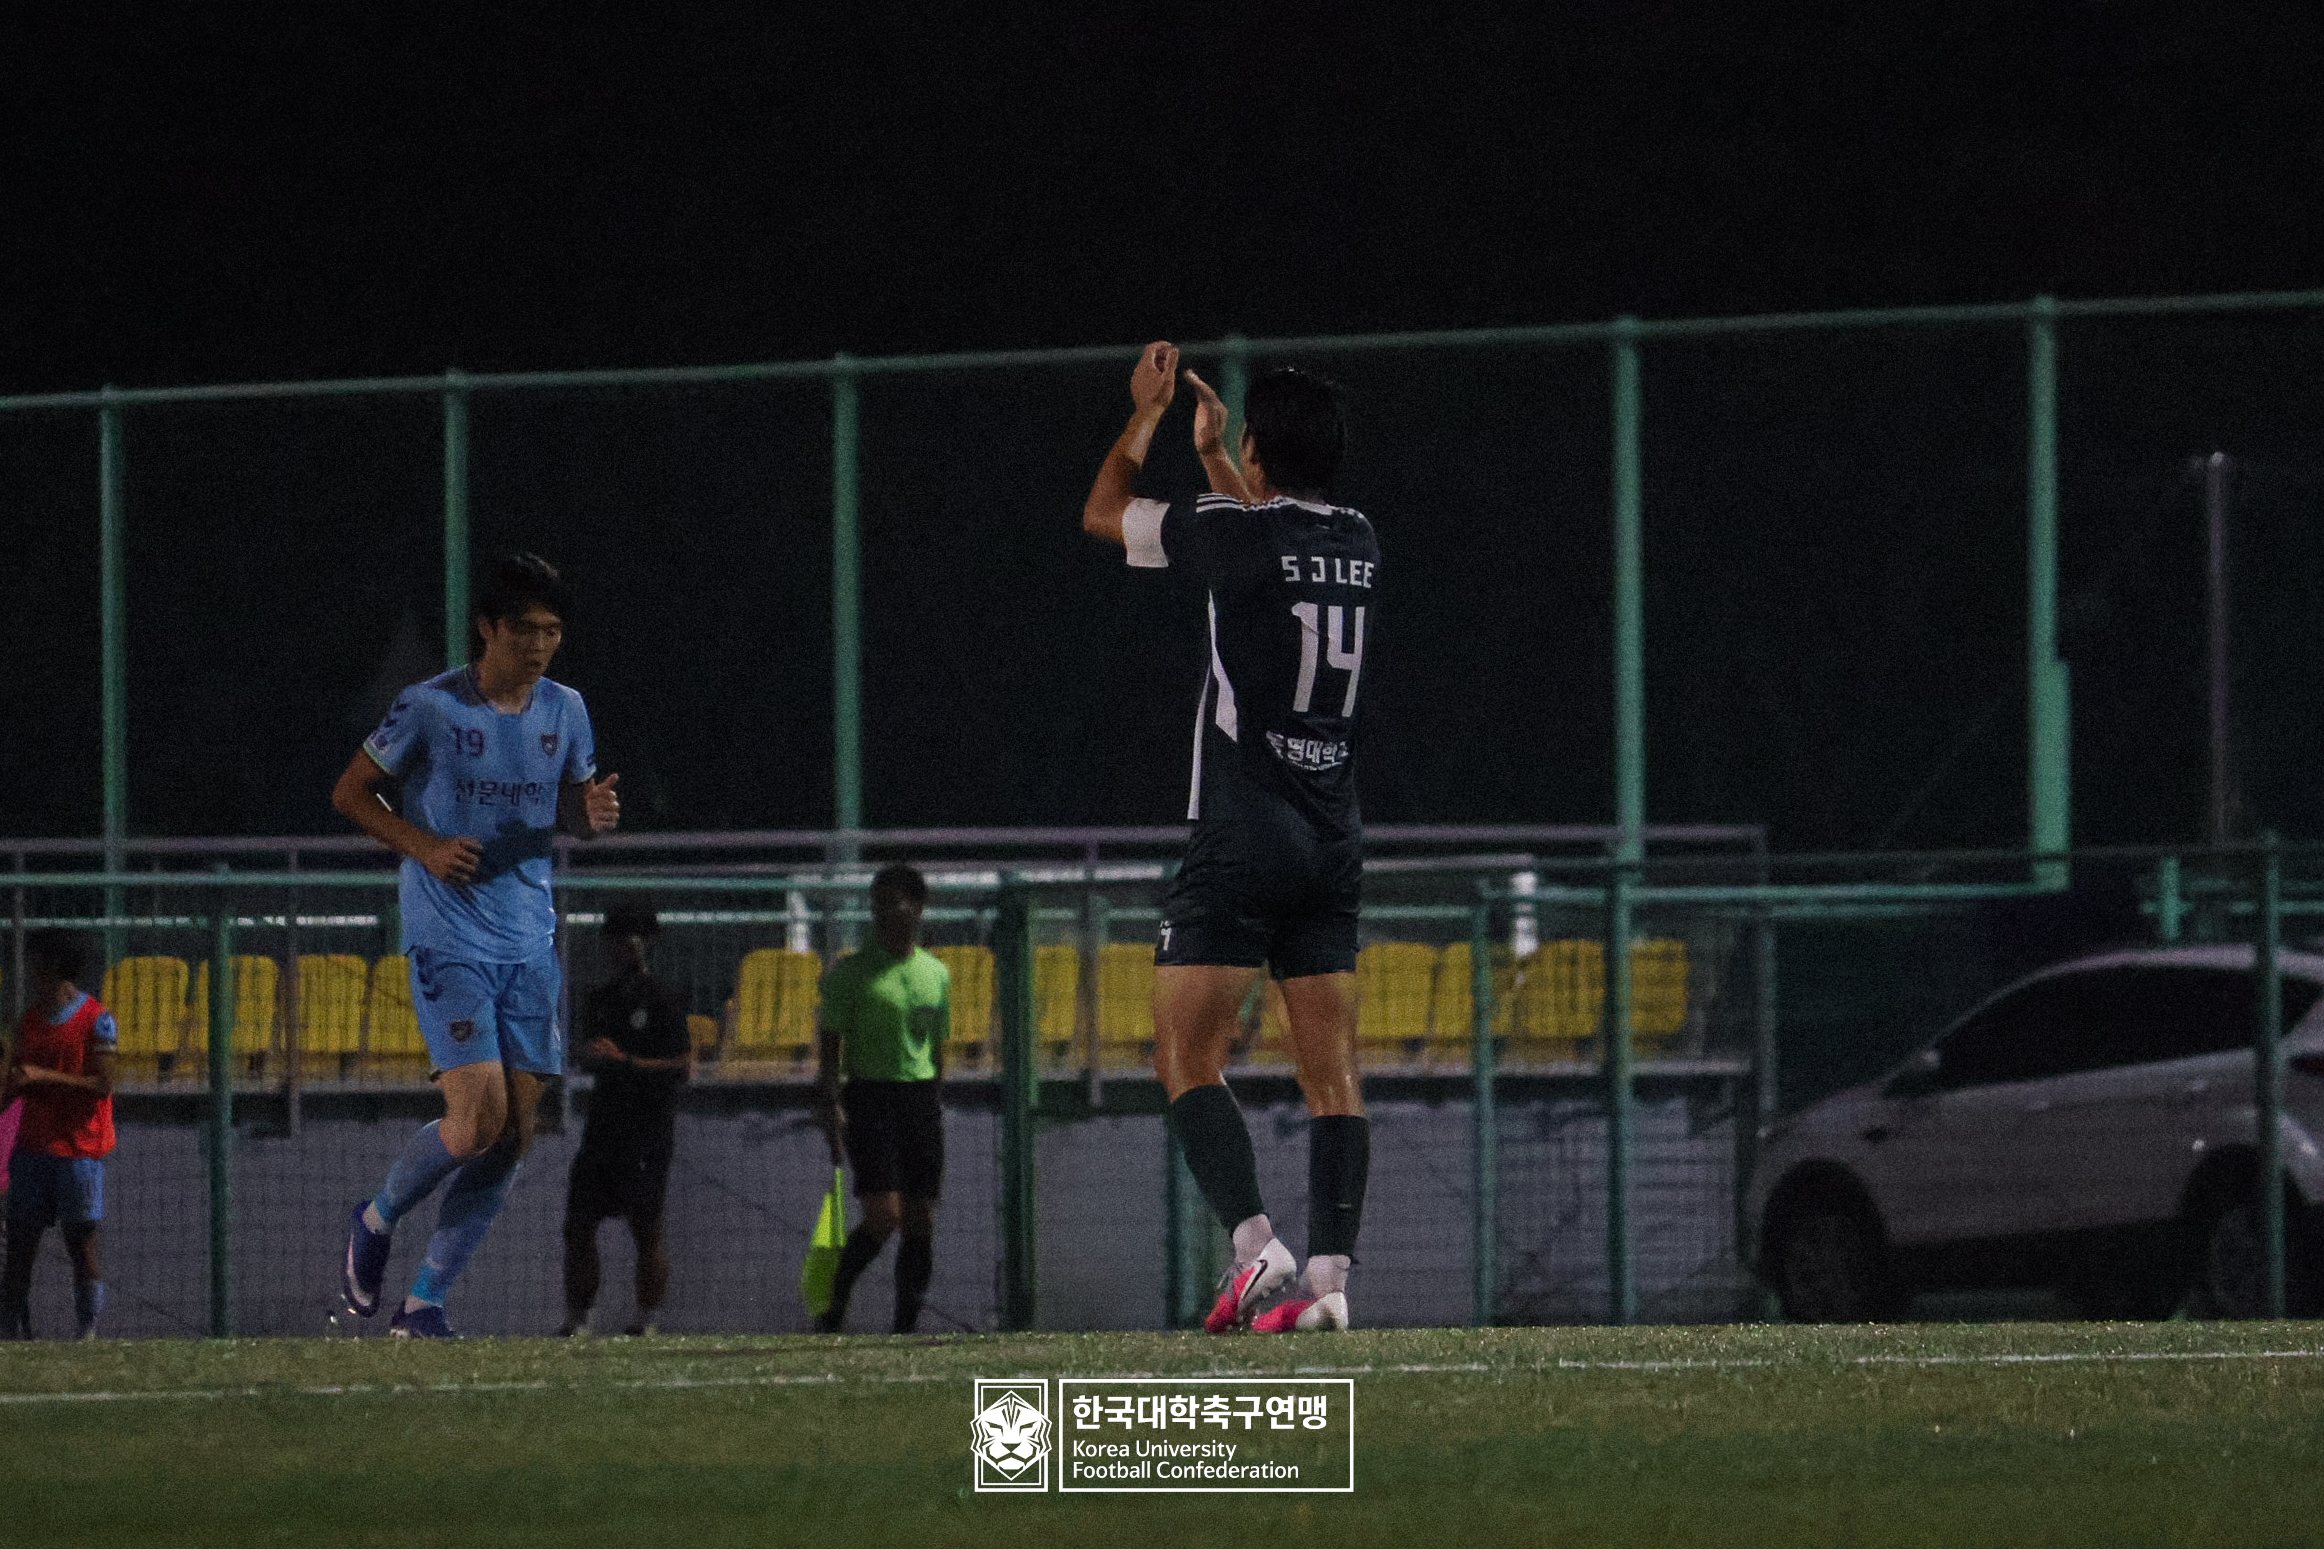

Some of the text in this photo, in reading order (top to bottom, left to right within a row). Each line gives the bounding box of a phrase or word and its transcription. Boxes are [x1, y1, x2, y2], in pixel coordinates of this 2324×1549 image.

[1281, 555, 1375, 589] S J LEE
[1291, 601, 1366, 718] 14
[452, 725, 485, 757] 19
